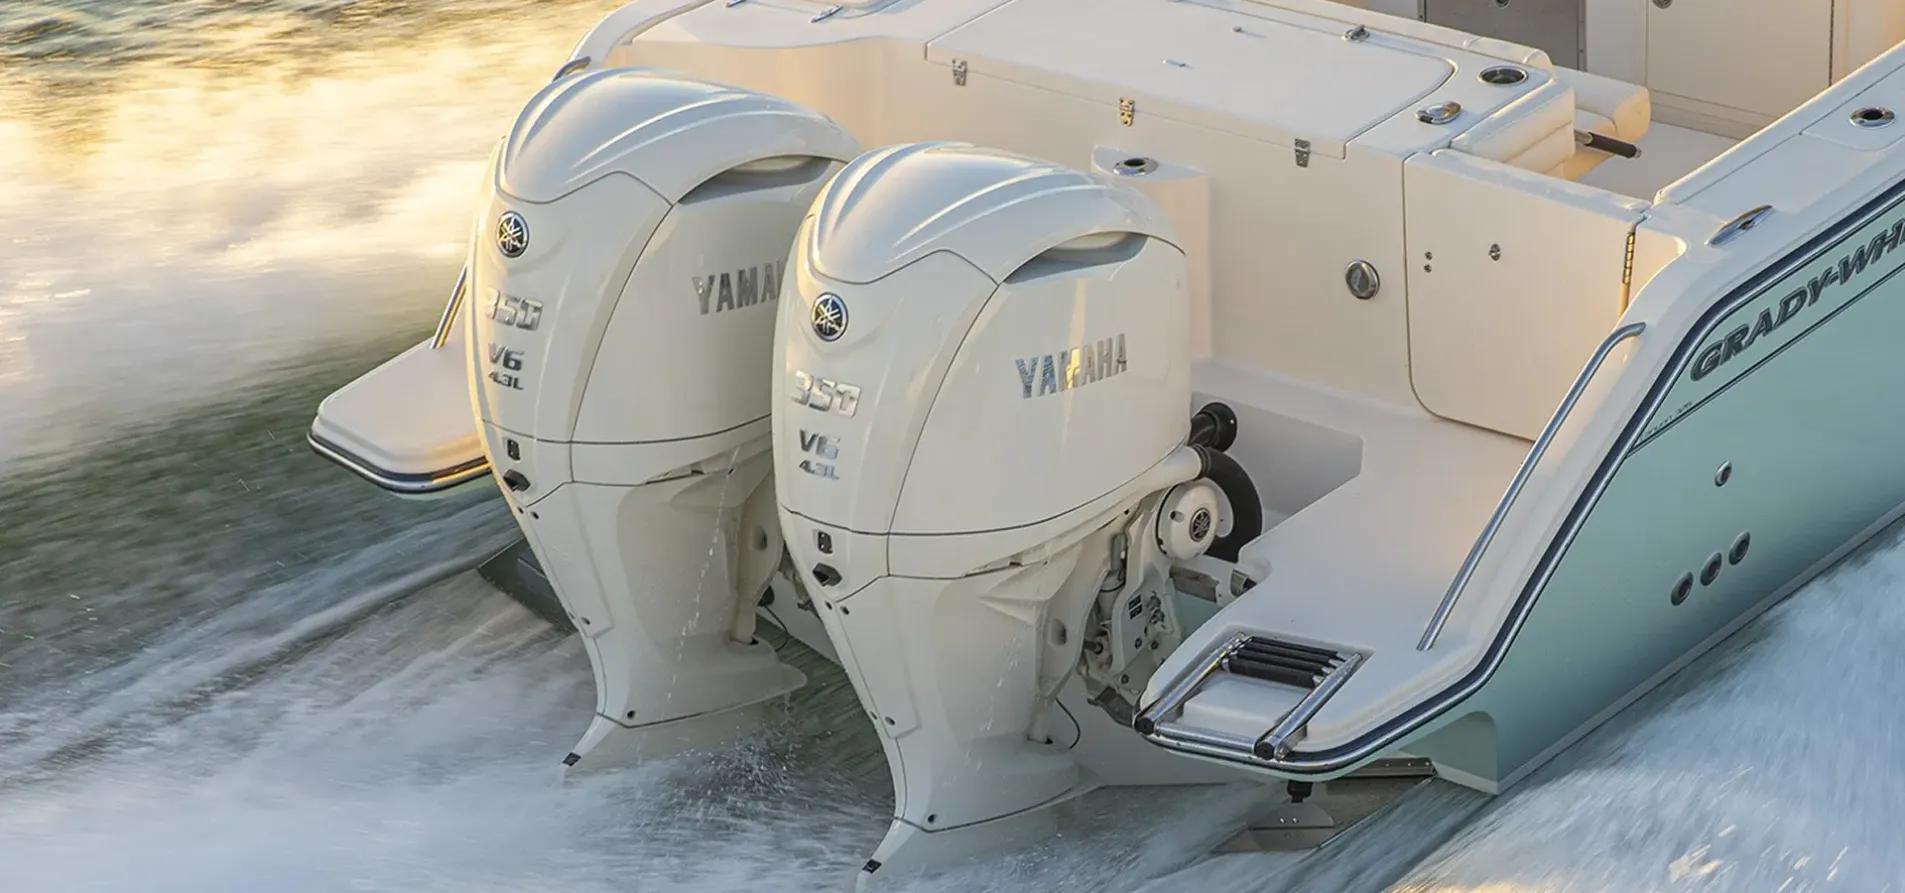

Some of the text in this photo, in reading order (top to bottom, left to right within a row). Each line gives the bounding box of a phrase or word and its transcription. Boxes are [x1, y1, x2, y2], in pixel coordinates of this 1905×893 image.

[486, 289, 544, 330] 350
[1690, 218, 1905, 382] GRADY-WH
[488, 342, 524, 371] V6
[1015, 333, 1127, 400] YAMAHA
[791, 369, 862, 419] 350
[799, 429, 840, 460] V6
[799, 459, 839, 480] 4.3L
